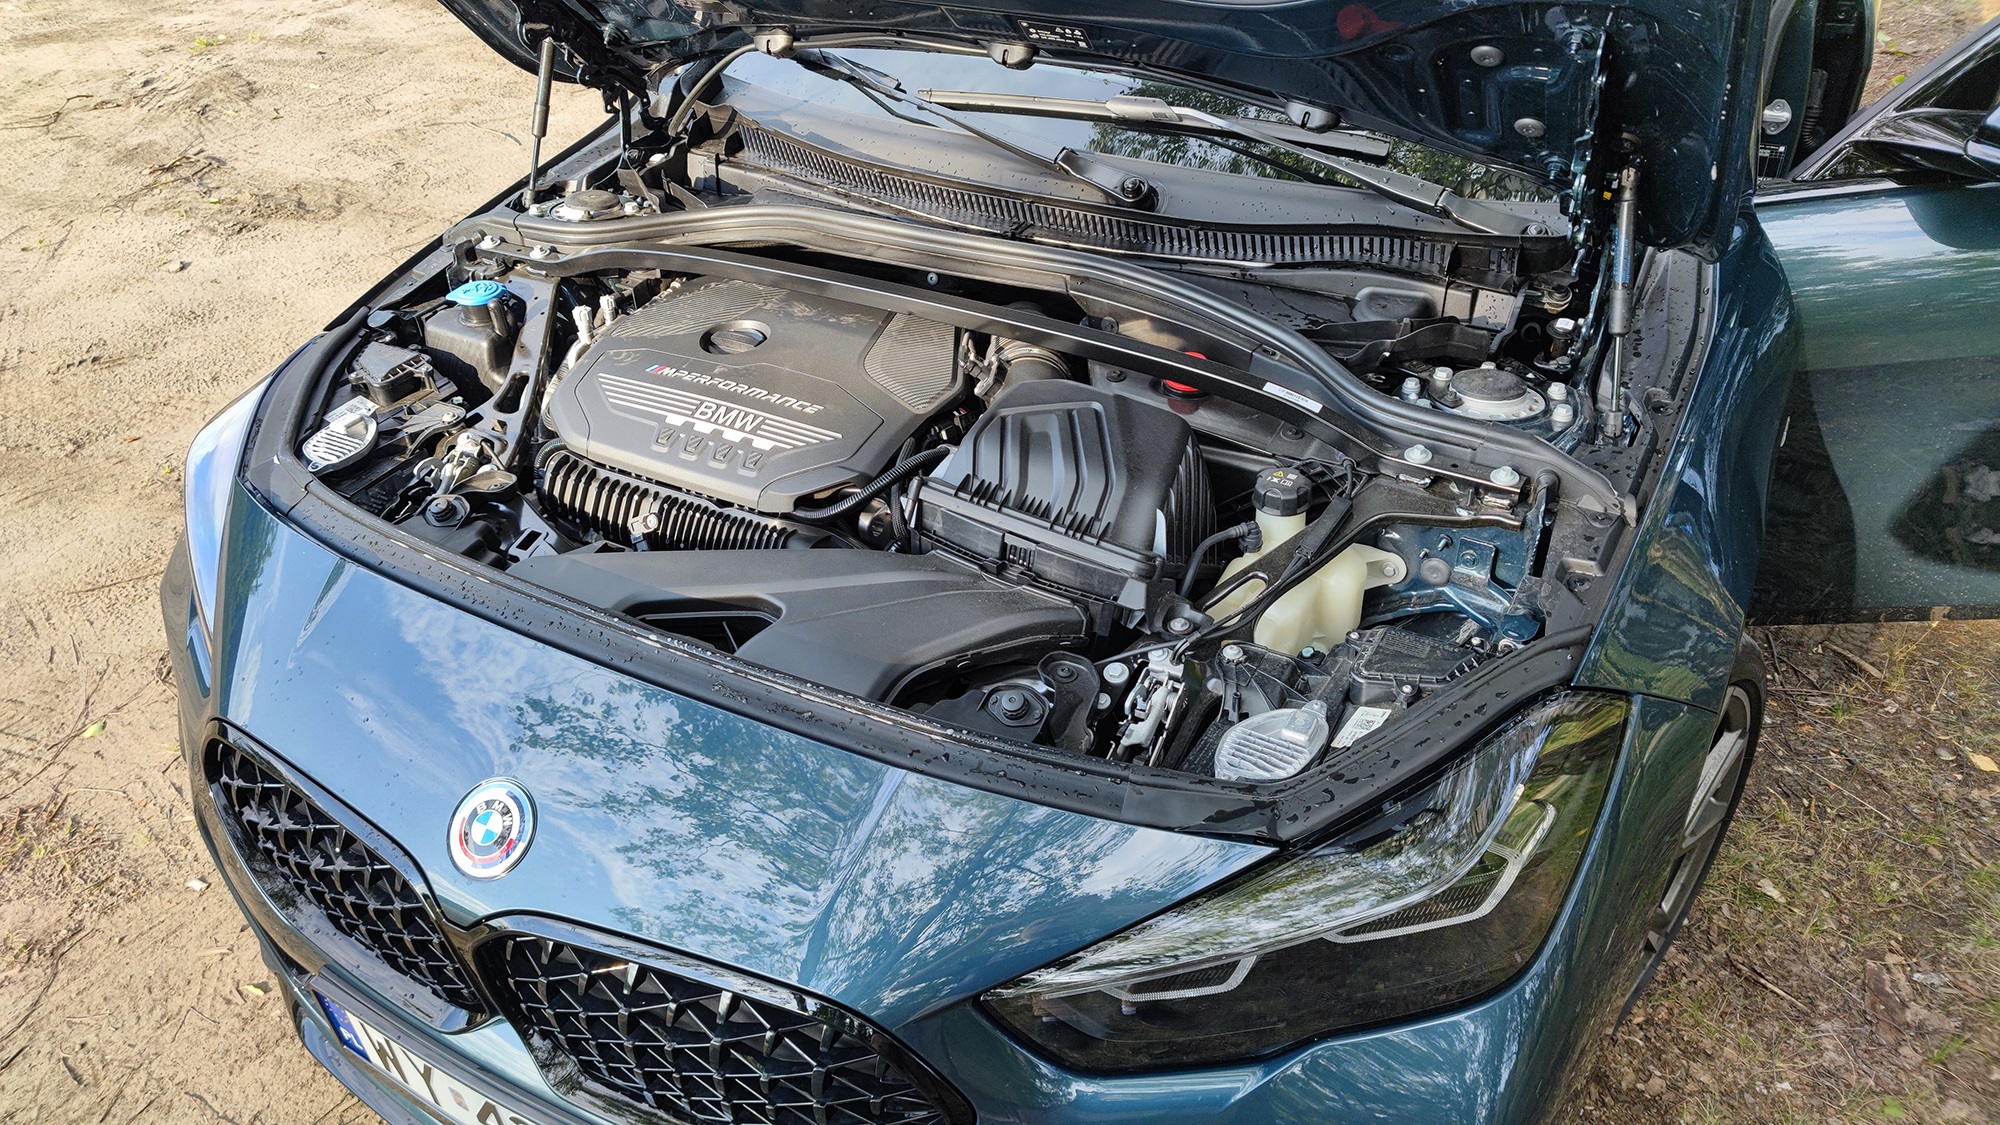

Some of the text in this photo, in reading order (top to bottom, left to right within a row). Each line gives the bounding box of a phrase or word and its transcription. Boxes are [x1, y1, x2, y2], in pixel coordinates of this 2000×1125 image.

[693, 401, 764, 433] BMW
[476, 800, 514, 827] BMW
[339, 1026, 364, 1050] PL
[358, 1019, 442, 1107] WY
